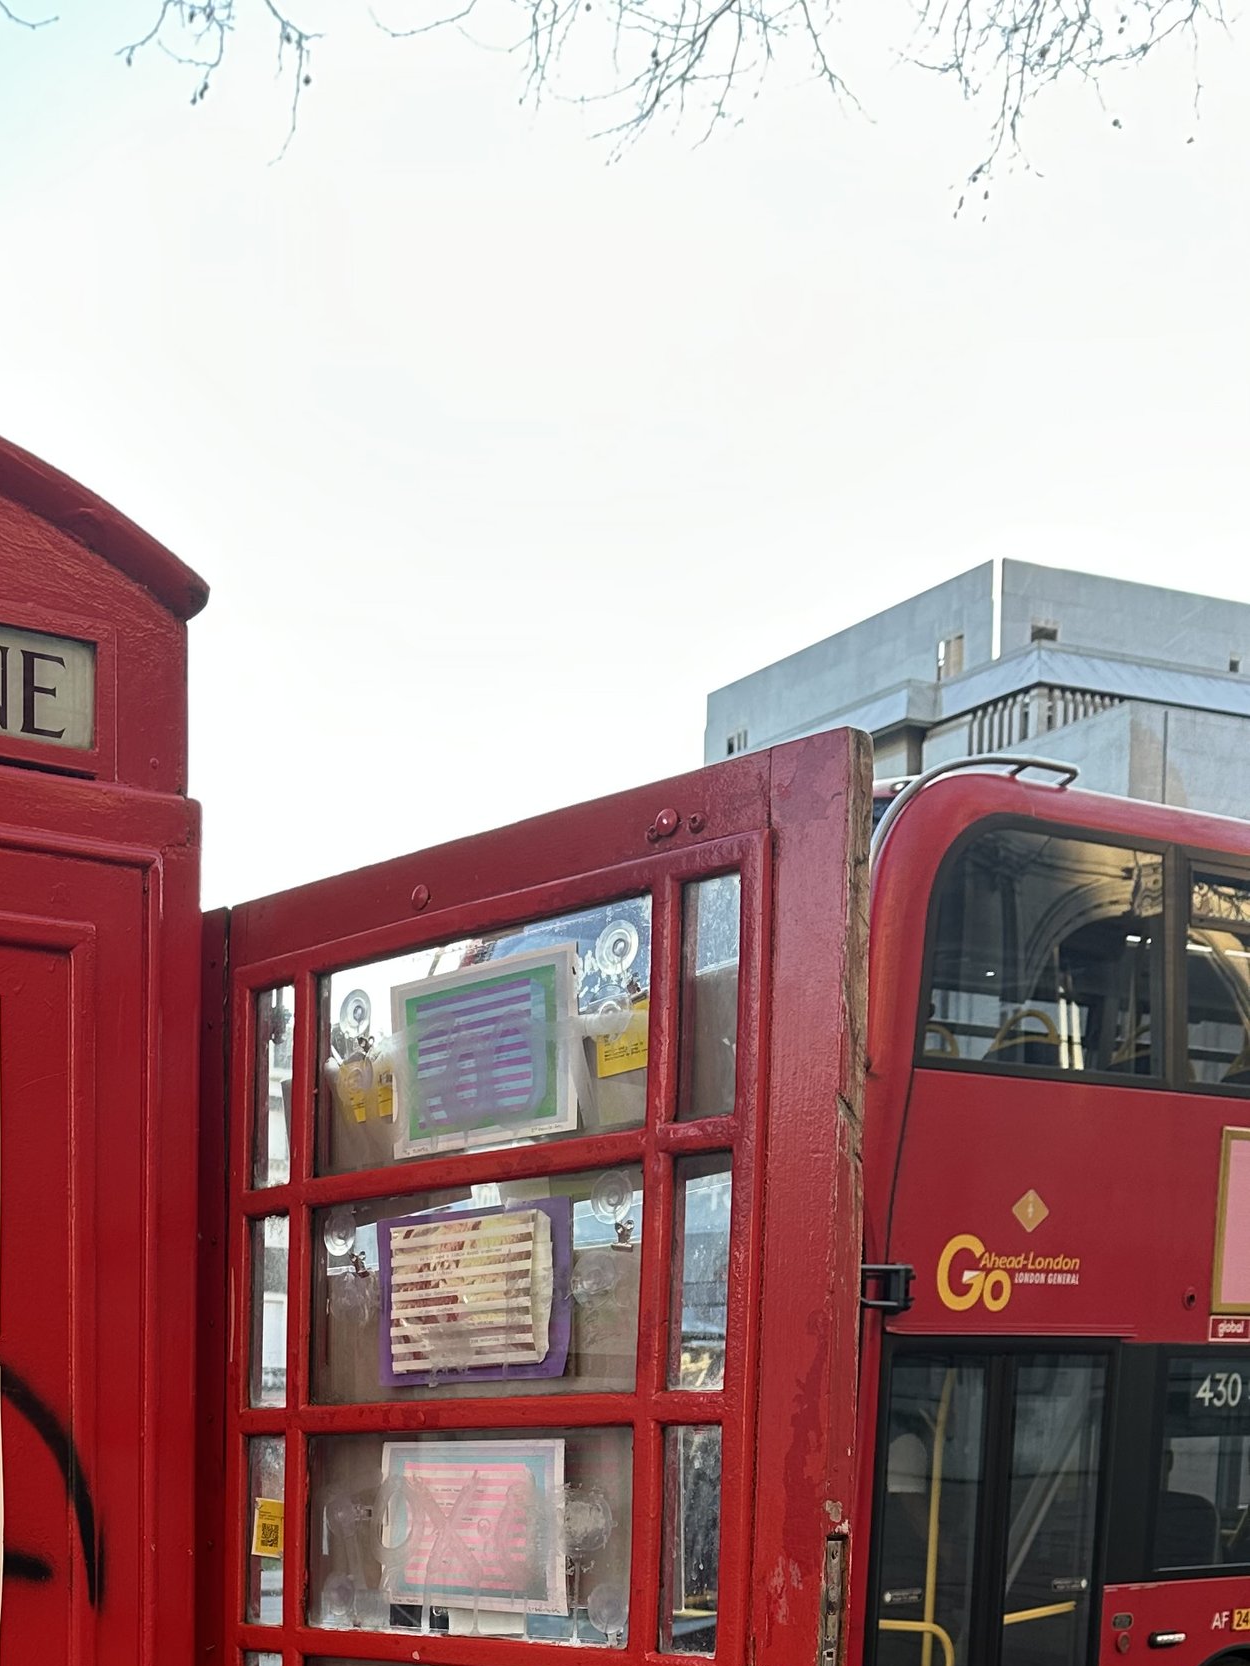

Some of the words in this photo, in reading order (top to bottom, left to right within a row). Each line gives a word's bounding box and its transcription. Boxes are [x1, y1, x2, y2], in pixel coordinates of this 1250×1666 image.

[937, 1234, 1012, 1312] Go
[979, 1251, 1080, 1271] Ahead-London
[1014, 1271, 1046, 1285] LONDON
[1047, 1273, 1079, 1285] GENERAL
[1218, 1320, 1244, 1337] global
[1196, 1372, 1243, 1407] 430
[1211, 1611, 1230, 1630] AF
